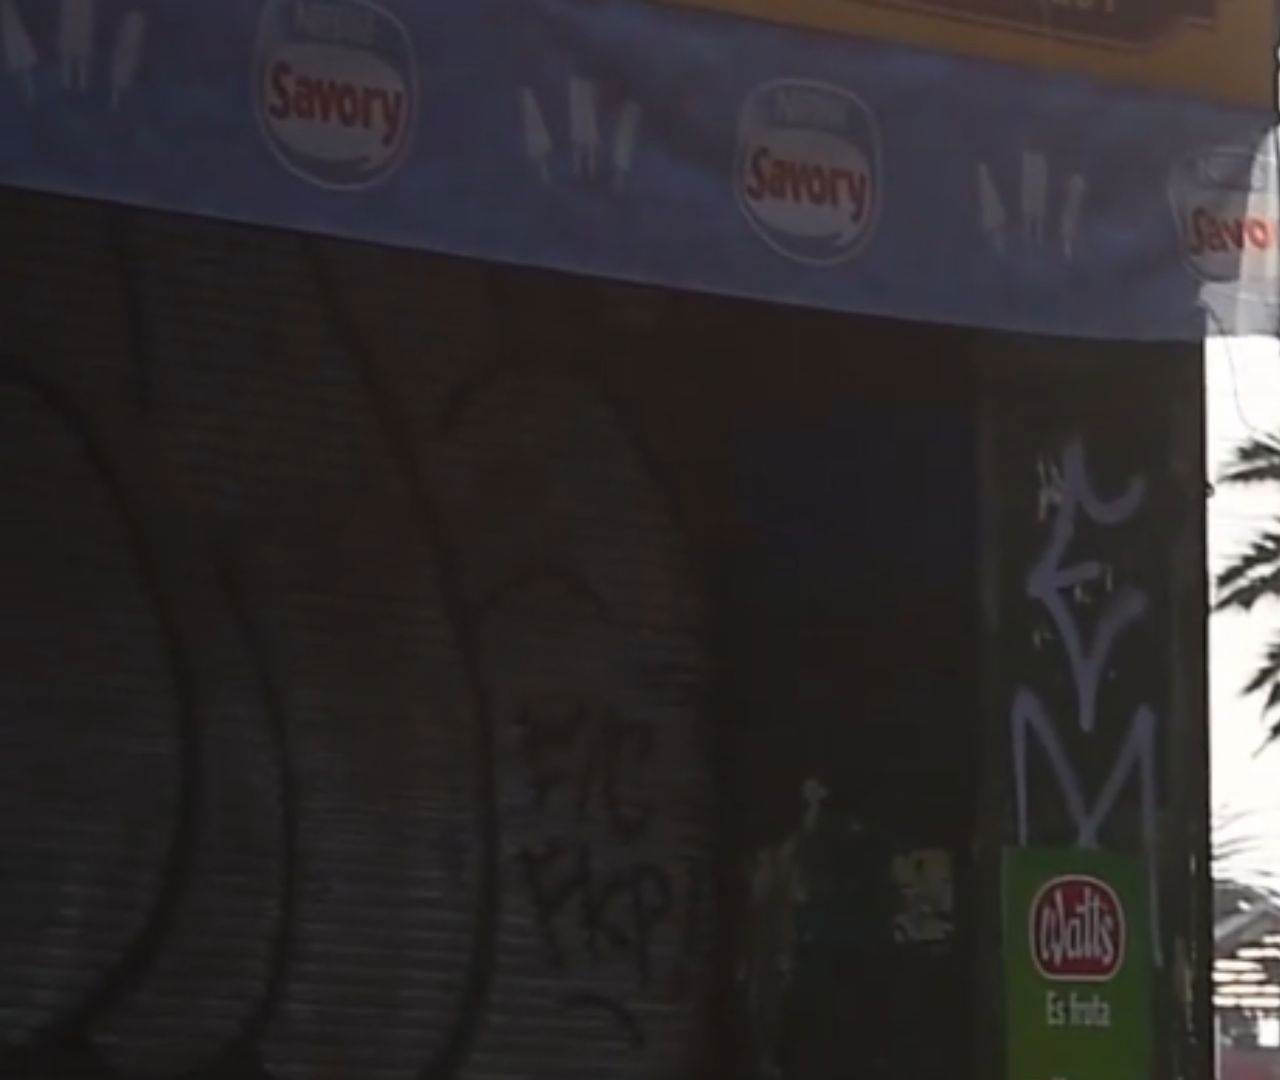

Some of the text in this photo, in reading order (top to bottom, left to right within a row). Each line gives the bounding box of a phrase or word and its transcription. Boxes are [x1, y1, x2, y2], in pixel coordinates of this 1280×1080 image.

[268, 61, 404, 147] Savory
[745, 146, 867, 223] Savory
[1045, 990, 1112, 1028] Es fruta
